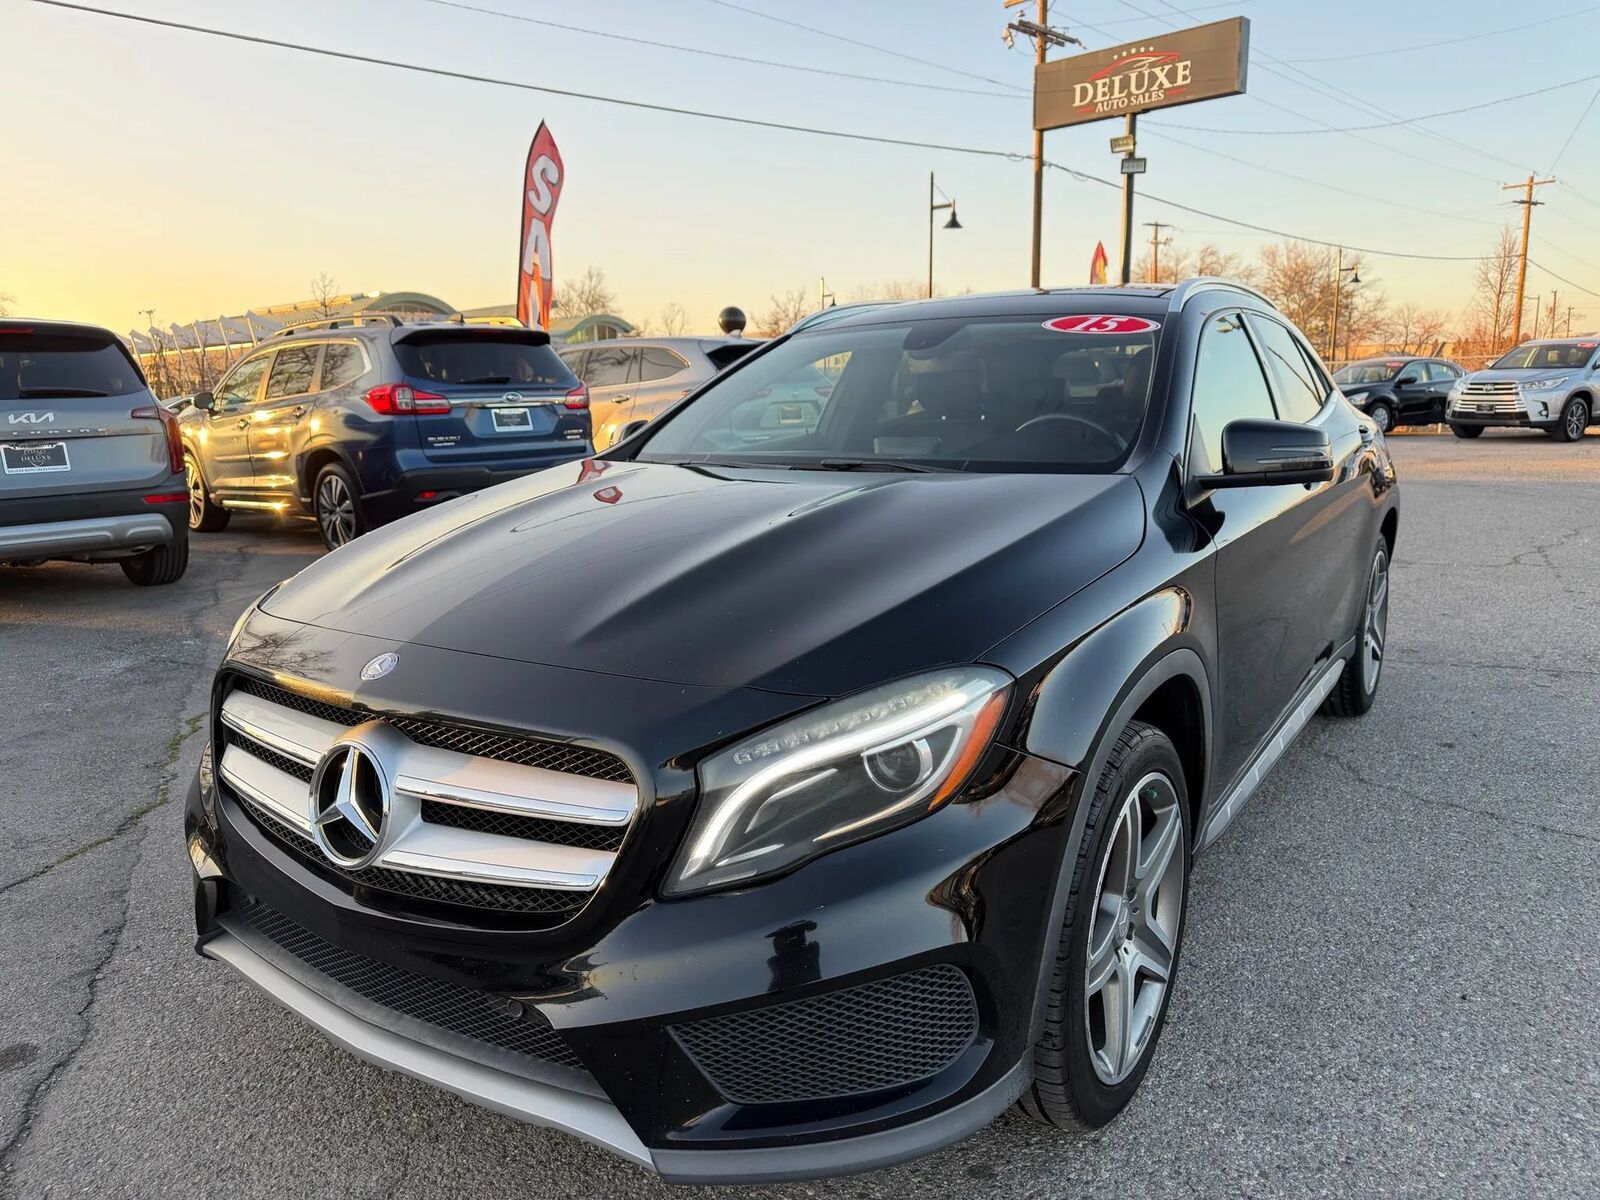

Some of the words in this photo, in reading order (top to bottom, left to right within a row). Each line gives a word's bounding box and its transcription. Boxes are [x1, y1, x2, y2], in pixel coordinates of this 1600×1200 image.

[1072, 60, 1192, 108] DELUXE
[1095, 97, 1128, 113] AUTO
[1130, 89, 1165, 106] SALES
[1067, 315, 1131, 332] 15
[8, 412, 55, 424] KIA
